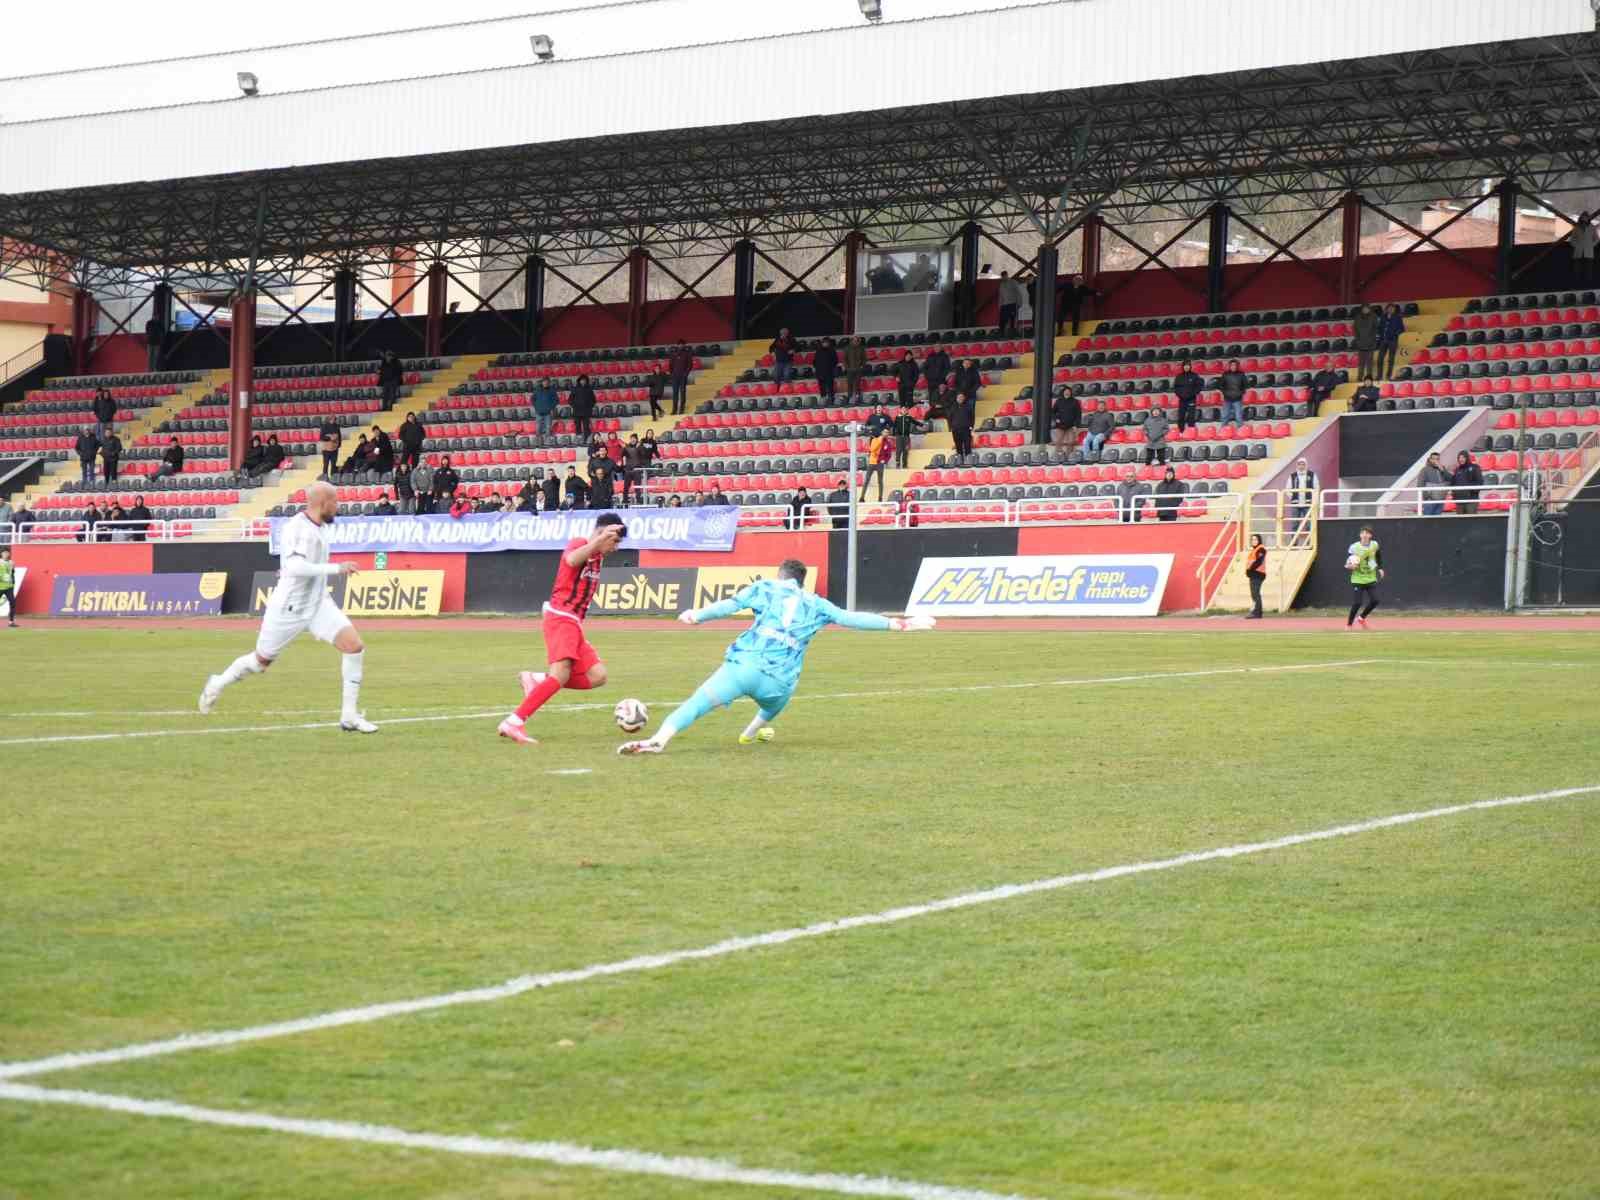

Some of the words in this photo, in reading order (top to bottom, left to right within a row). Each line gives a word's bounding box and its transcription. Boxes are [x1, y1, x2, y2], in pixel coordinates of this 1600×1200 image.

[368, 515, 424, 544] DÜNYA
[428, 519, 512, 544] KADINLAR
[513, 515, 566, 541] GÜNÜ
[630, 518, 690, 541] OLSUN
[986, 566, 1087, 604] hedef
[1085, 584, 1149, 599] market
